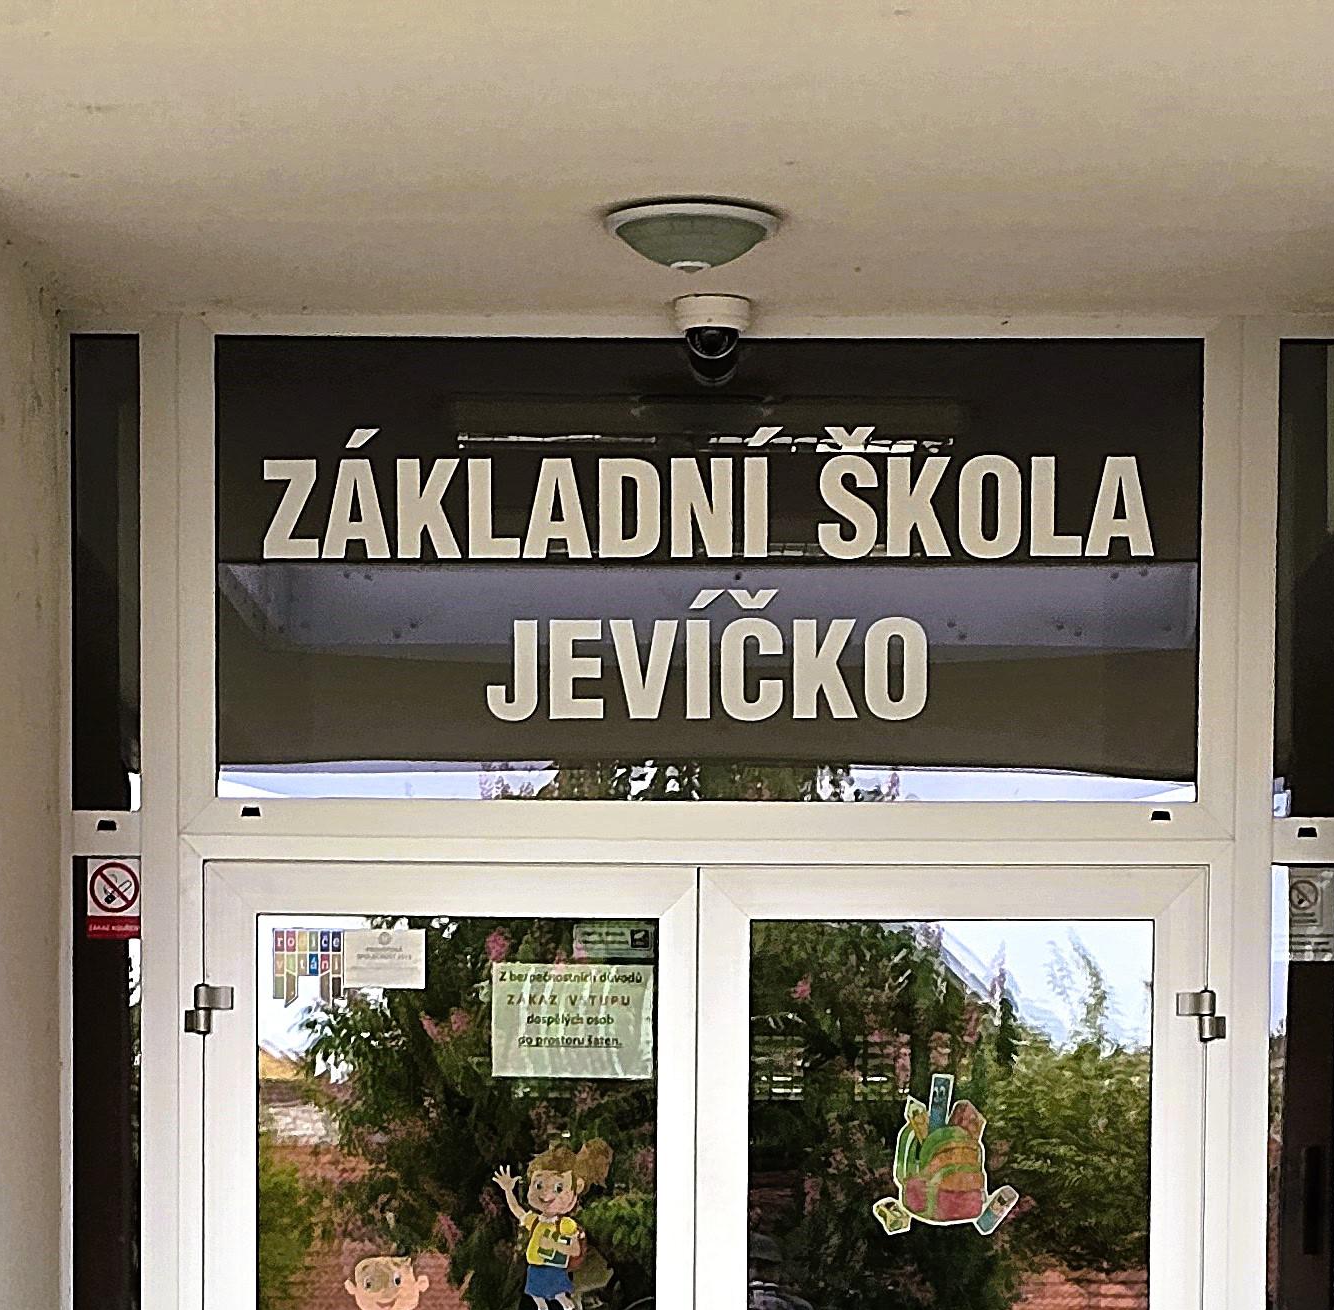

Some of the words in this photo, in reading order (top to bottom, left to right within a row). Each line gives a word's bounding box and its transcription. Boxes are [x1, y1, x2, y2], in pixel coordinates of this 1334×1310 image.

[263, 427, 769, 559] ZÁKLADNÍ
[817, 426, 1155, 559] ŠKOLA
[486, 588, 928, 721] JEVÍČKO
[498, 972, 507, 982] Z
[569, 994, 631, 1006] VTUPU
[586, 1014, 614, 1025] osob
